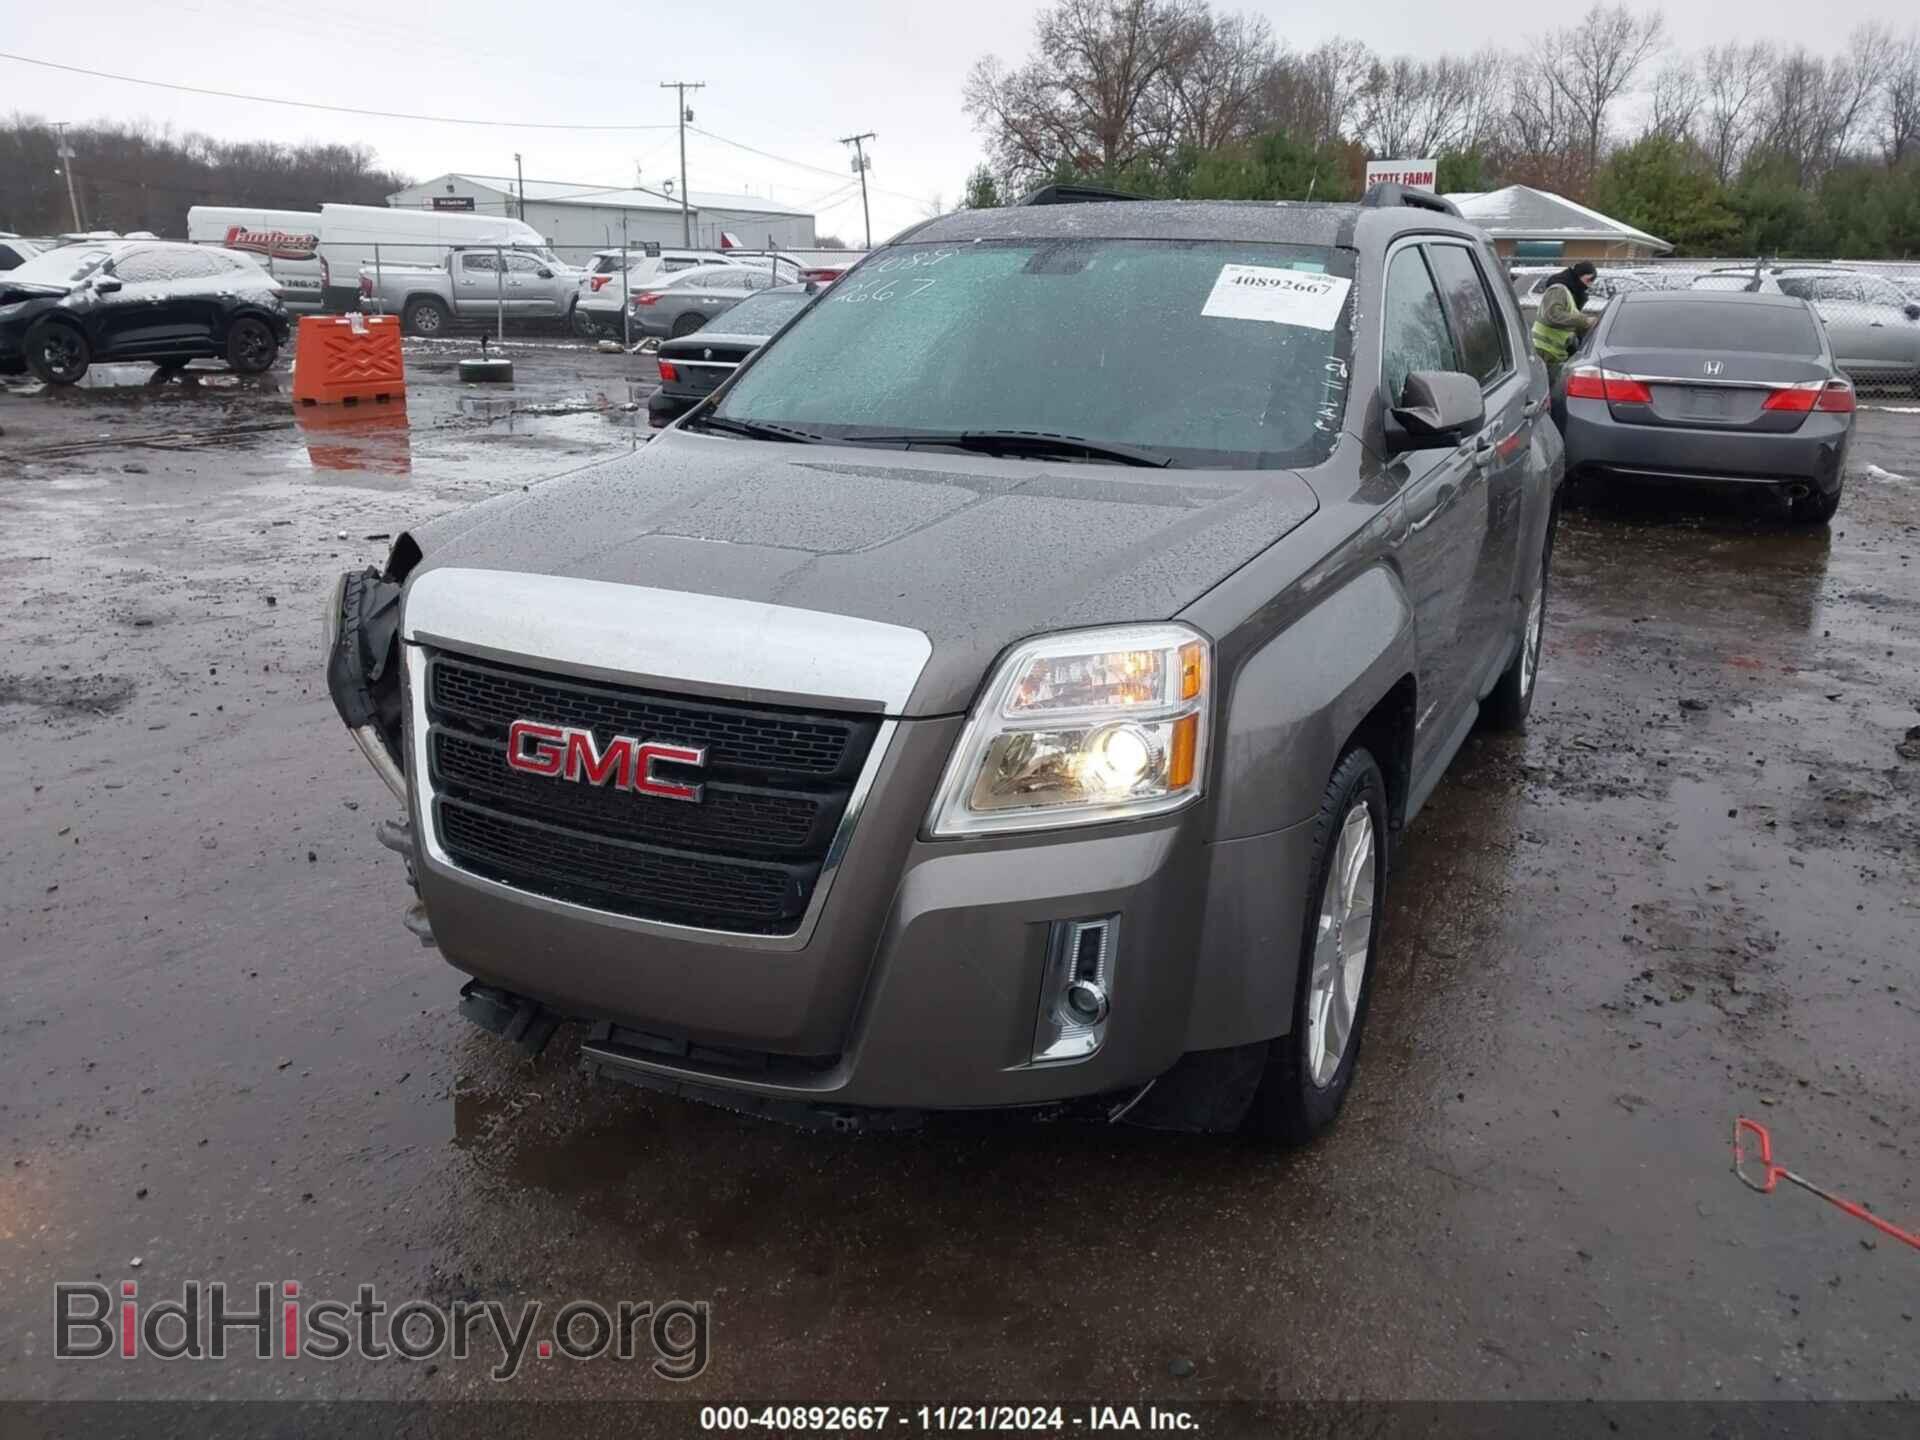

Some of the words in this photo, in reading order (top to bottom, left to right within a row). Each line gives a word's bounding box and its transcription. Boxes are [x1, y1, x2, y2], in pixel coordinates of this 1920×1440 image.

[1369, 172, 1400, 186] STATE
[1403, 171, 1433, 185] FARM
[1231, 275, 1332, 296] 40892667
[507, 719, 706, 803] GMC
